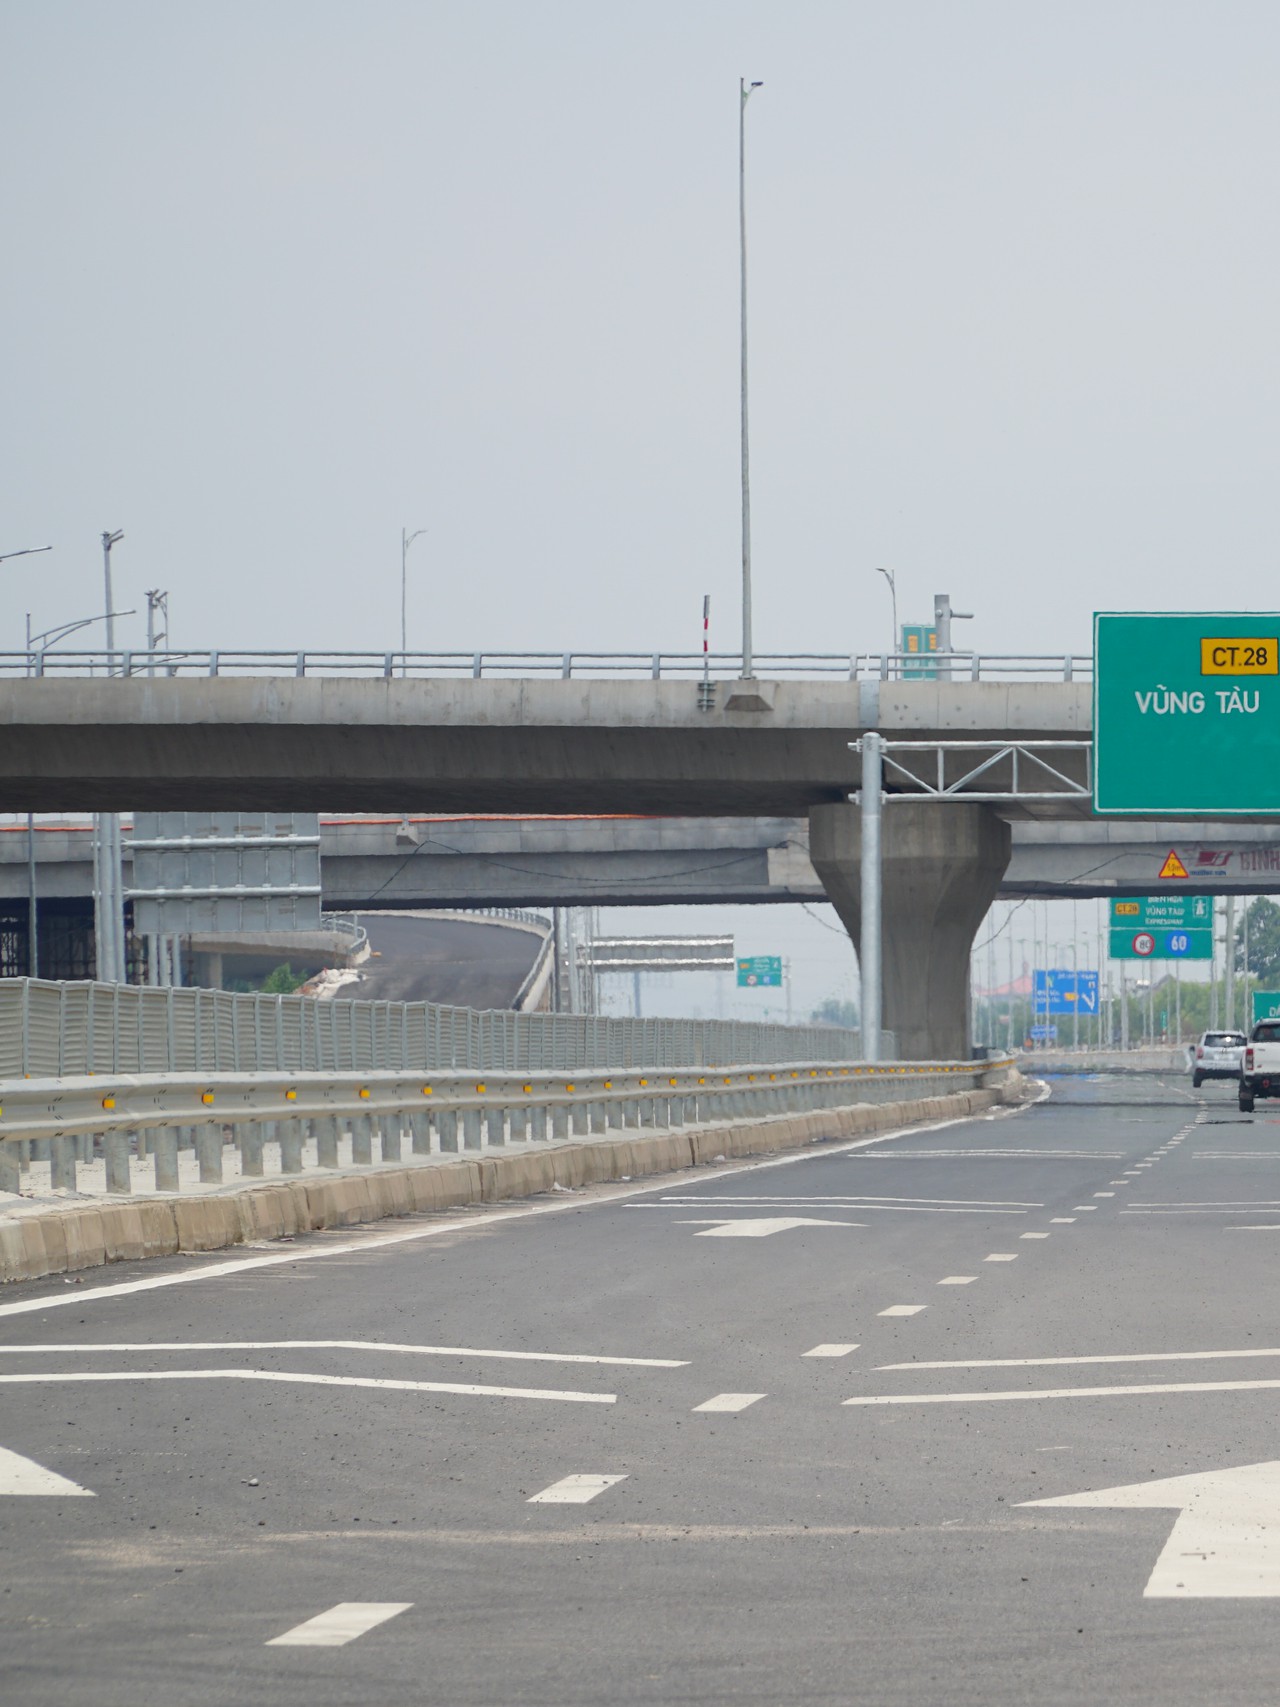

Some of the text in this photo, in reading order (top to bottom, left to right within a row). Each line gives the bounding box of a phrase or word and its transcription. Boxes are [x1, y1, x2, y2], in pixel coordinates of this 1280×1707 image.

[1212, 647, 1268, 667] CT.28
[1134, 684, 1260, 715] VŨNG TÀU
[1171, 935, 1187, 951] 60
